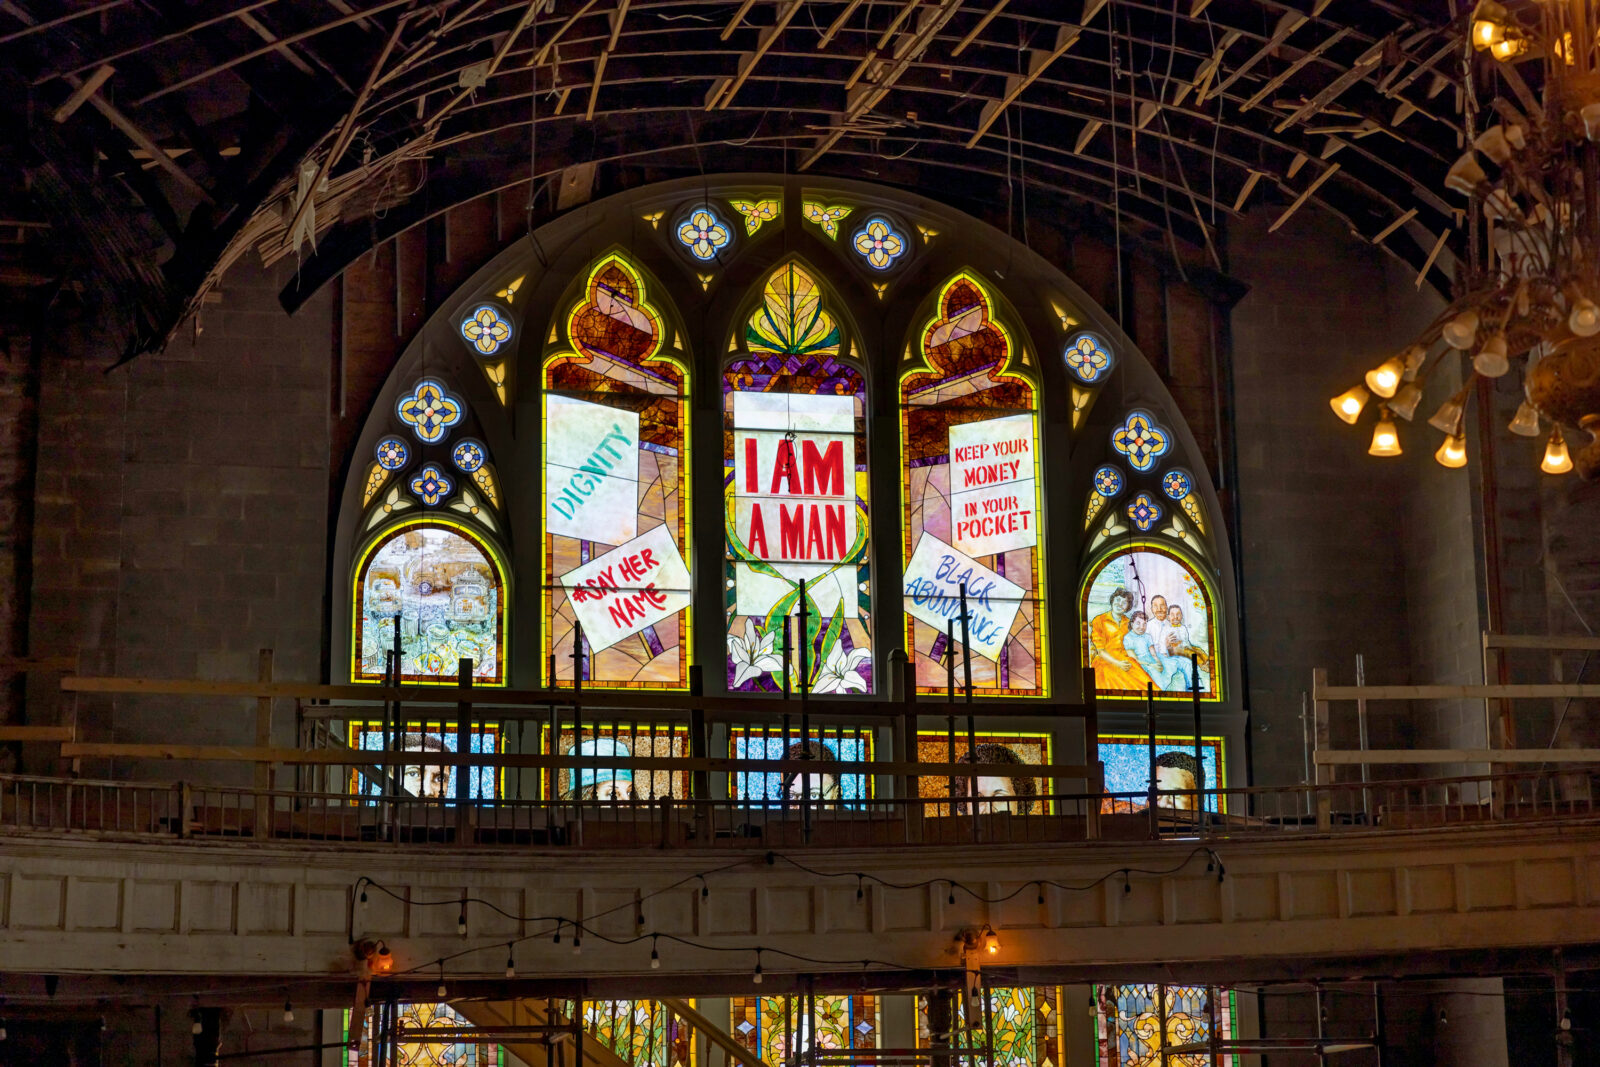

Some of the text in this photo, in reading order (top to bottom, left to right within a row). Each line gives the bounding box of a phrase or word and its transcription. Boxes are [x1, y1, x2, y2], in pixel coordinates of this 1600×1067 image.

[551, 423, 632, 520] DIGNITY
[745, 438, 845, 496] I AM
[955, 438, 1029, 463] KEEP YOUR
[964, 459, 1021, 488] MONEY
[748, 503, 847, 561] A MAN
[957, 510, 1031, 541] POCKET
[964, 495, 1019, 518] IN YOUR
[572, 548, 660, 603] #SAY HER
[935, 554, 996, 613] BLACK
[608, 582, 668, 629] NAME
